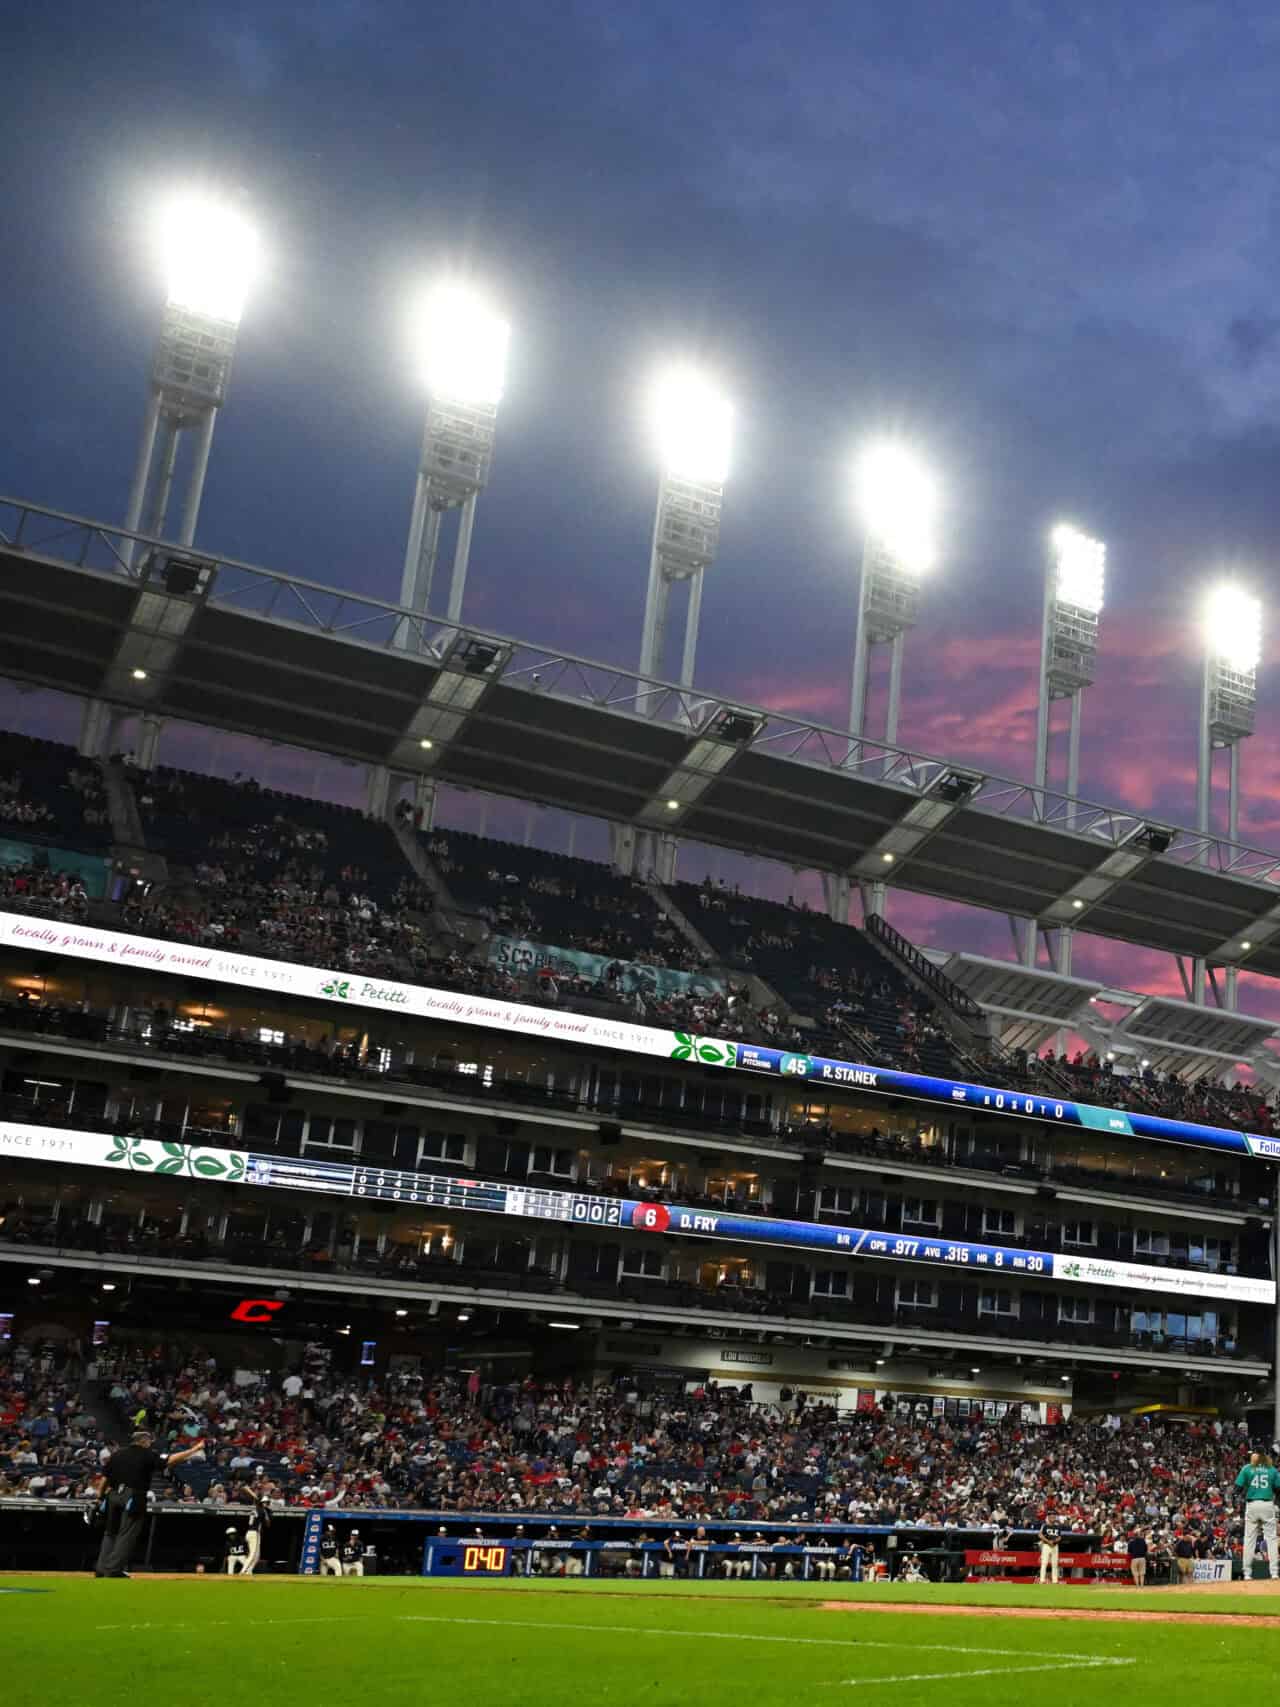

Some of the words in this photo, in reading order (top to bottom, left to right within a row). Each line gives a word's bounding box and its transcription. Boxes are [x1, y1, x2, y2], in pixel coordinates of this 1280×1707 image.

[12, 924, 57, 943] locally
[62, 934, 103, 949] grown
[107, 943, 117, 953] &
[119, 943, 165, 963] family
[170, 953, 211, 968] owned
[217, 961, 257, 977] SINCE
[360, 983, 409, 1004] Petitti
[426, 997, 464, 1014] locally
[466, 1005, 501, 1019] grown
[513, 1013, 551, 1031] family
[554, 1022, 589, 1033] owned
[593, 1027, 625, 1040] SINCE
[787, 1057, 807, 1075] 45
[835, 1068, 877, 1086] STANEK
[996, 1094, 1004, 1108] 0
[1025, 1100, 1033, 1113] 0
[1055, 1105, 1063, 1118] 0
[360, 1175, 367, 1183] 0
[377, 1178, 384, 1186] 0
[410, 1192, 418, 1200] 0
[427, 1194, 434, 1202] 0
[575, 1203, 586, 1218] 0
[590, 1205, 602, 1221] 0
[607, 1207, 619, 1223] 2
[645, 1209, 657, 1226] 6
[694, 1216, 718, 1231] FRY
[871, 1239, 887, 1251] OPS
[892, 1240, 920, 1256] .977
[924, 1246, 940, 1258] AVG
[944, 1247, 969, 1263] .315
[995, 1252, 1004, 1266] 8
[1027, 1256, 1043, 1271] 30
[1250, 1475, 1269, 1489] 45
[464, 1547, 505, 1571] 040
